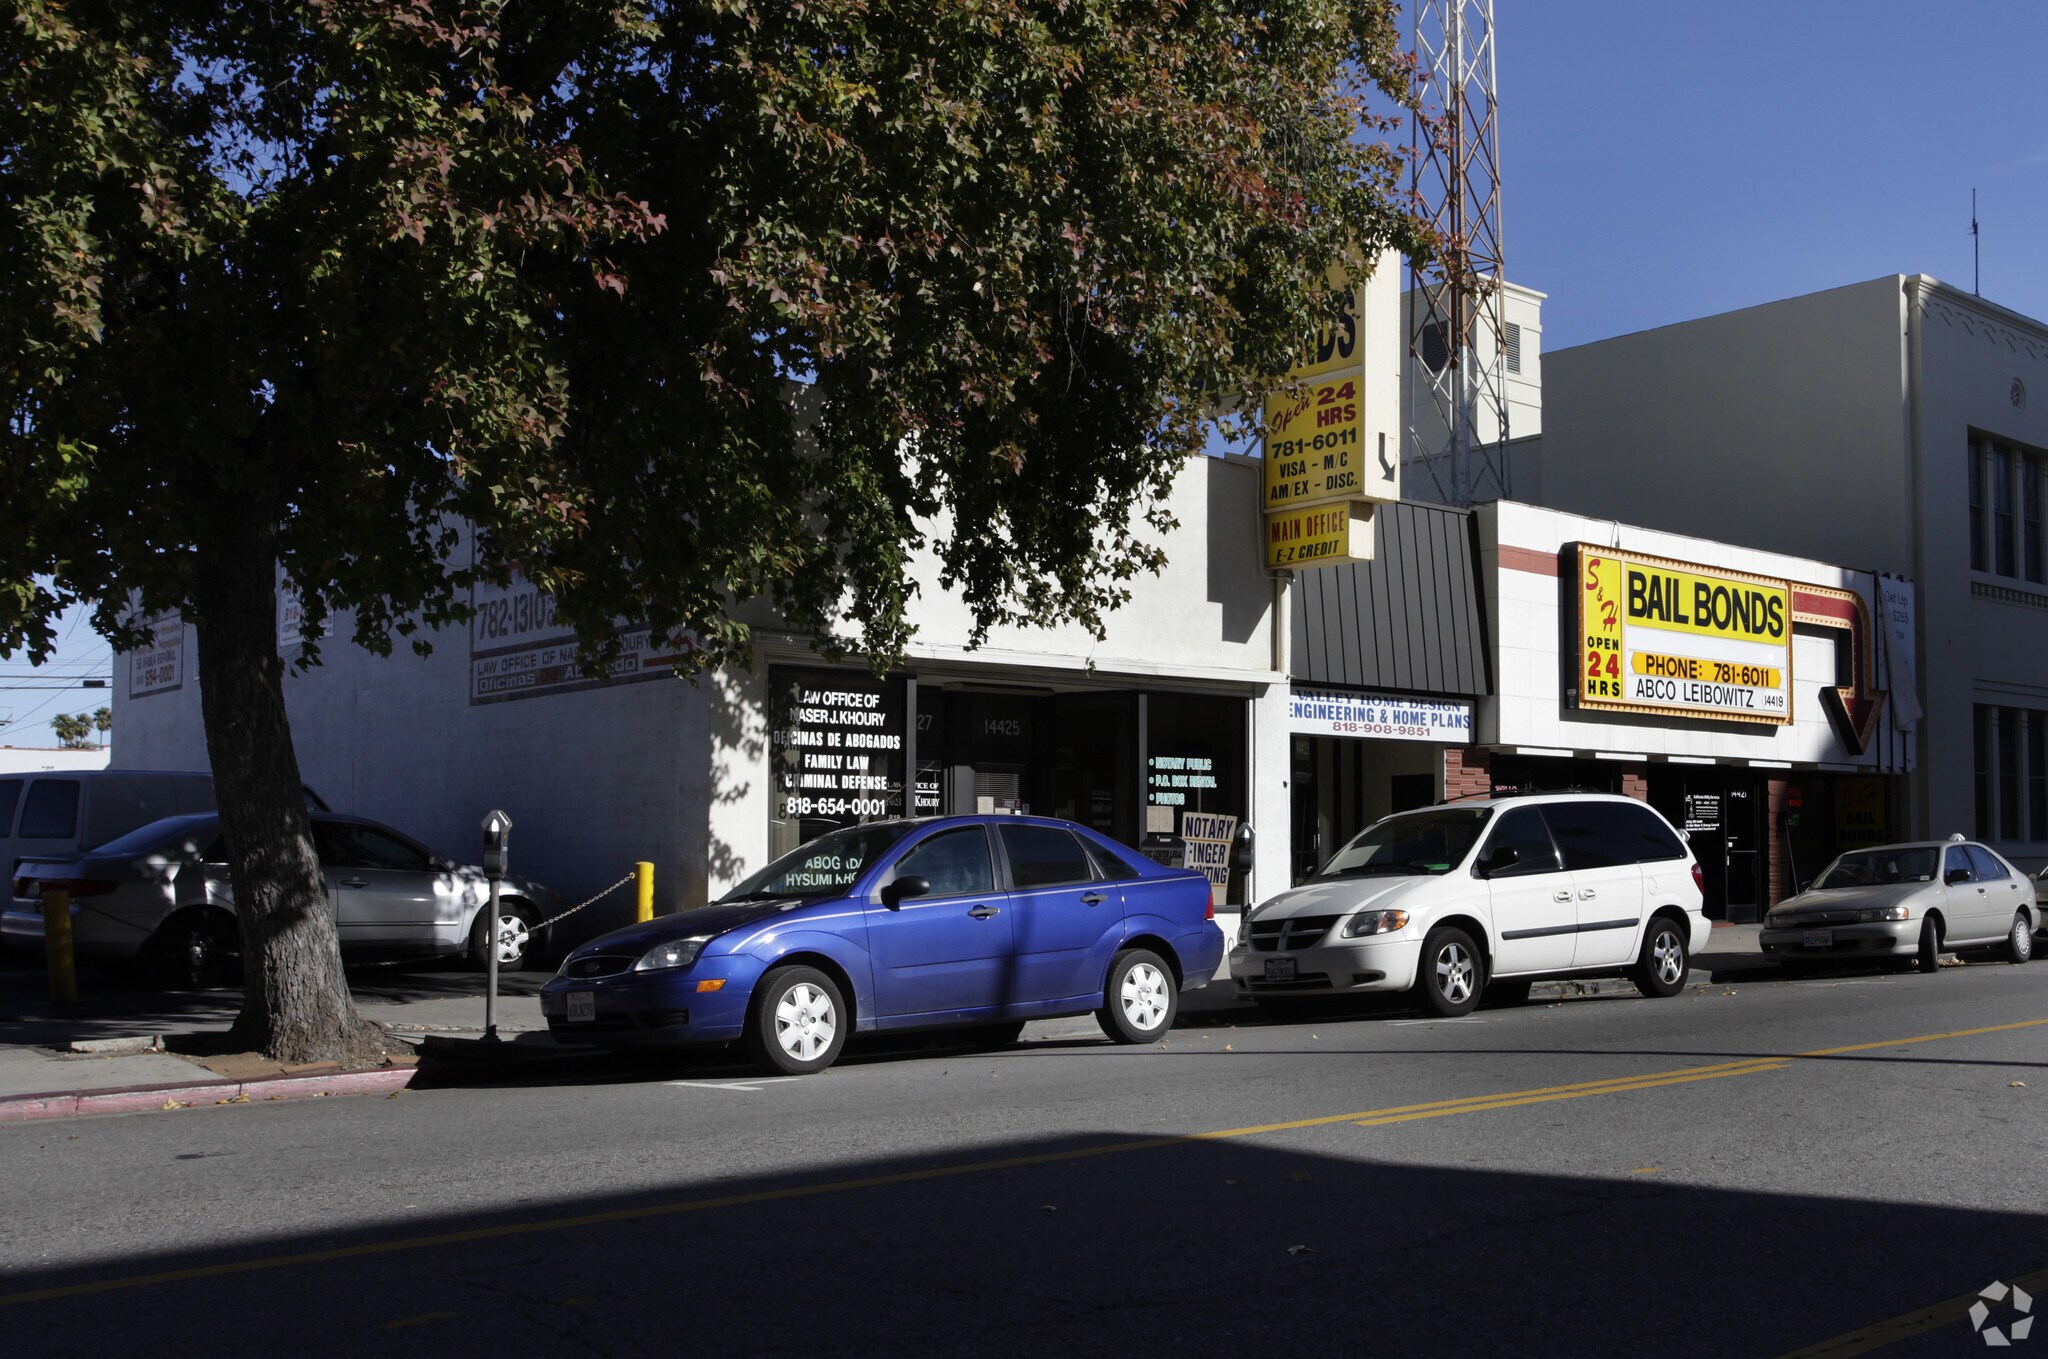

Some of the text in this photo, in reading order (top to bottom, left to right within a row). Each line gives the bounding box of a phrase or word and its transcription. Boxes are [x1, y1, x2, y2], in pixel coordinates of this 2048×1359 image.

[1270, 381, 1357, 436] Open 24
[1316, 403, 1357, 428] HRS
[1271, 427, 1357, 459] 781-6011
[1279, 460, 1306, 479] VISA
[1324, 451, 1348, 471] M/C
[1270, 480, 1309, 501] AM/EX
[1326, 471, 1358, 491] DISC.
[1271, 510, 1345, 544] MAIN OFFICE
[1276, 540, 1340, 563] E-Z CREDIT
[1585, 558, 1601, 591] S
[1600, 600, 1619, 632] H
[1627, 570, 1784, 639] BAIL BONDS
[478, 659, 498, 676] LAW
[501, 653, 537, 672] OFFICE
[542, 650, 556, 666] OF
[621, 631, 652, 653] OURY
[1587, 636, 1619, 651] OPEN
[1587, 651, 1620, 679] 24
[1645, 654, 1703, 680] PHONE:
[1587, 679, 1621, 698] HRS
[1635, 678, 1755, 709] ABCO LEIBOWITZ
[822, 690, 863, 707] OFFICE
[863, 693, 880, 709] OF
[1296, 690, 1462, 712] VALLEY HOME DESIGN
[1763, 694, 1785, 708] 14419
[790, 706, 886, 727] NASER J. KHOURY
[1379, 708, 1389, 724] &
[1392, 709, 1427, 727] HOME
[1431, 711, 1471, 730] PLANS
[984, 719, 1021, 737] 14425
[1332, 721, 1431, 737] 818-908-9851
[827, 732, 841, 747] DE
[845, 733, 901, 750] ABOGADOS
[804, 753, 869, 770] FAMILY LAW
[1155, 756, 1212, 771] NOTARY PUBLIC
[785, 773, 887, 790] CRIMINAL DEFENSE
[1171, 774, 1188, 788] BOX
[1189, 775, 1218, 789] RENTAL
[786, 797, 886, 816] 818-654-0001
[1155, 792, 1186, 806] PHOTOS
[1184, 816, 1234, 841] NOTARY
[1839, 829, 1884, 843] BONDS
[785, 873, 833, 887] HYSUMI
